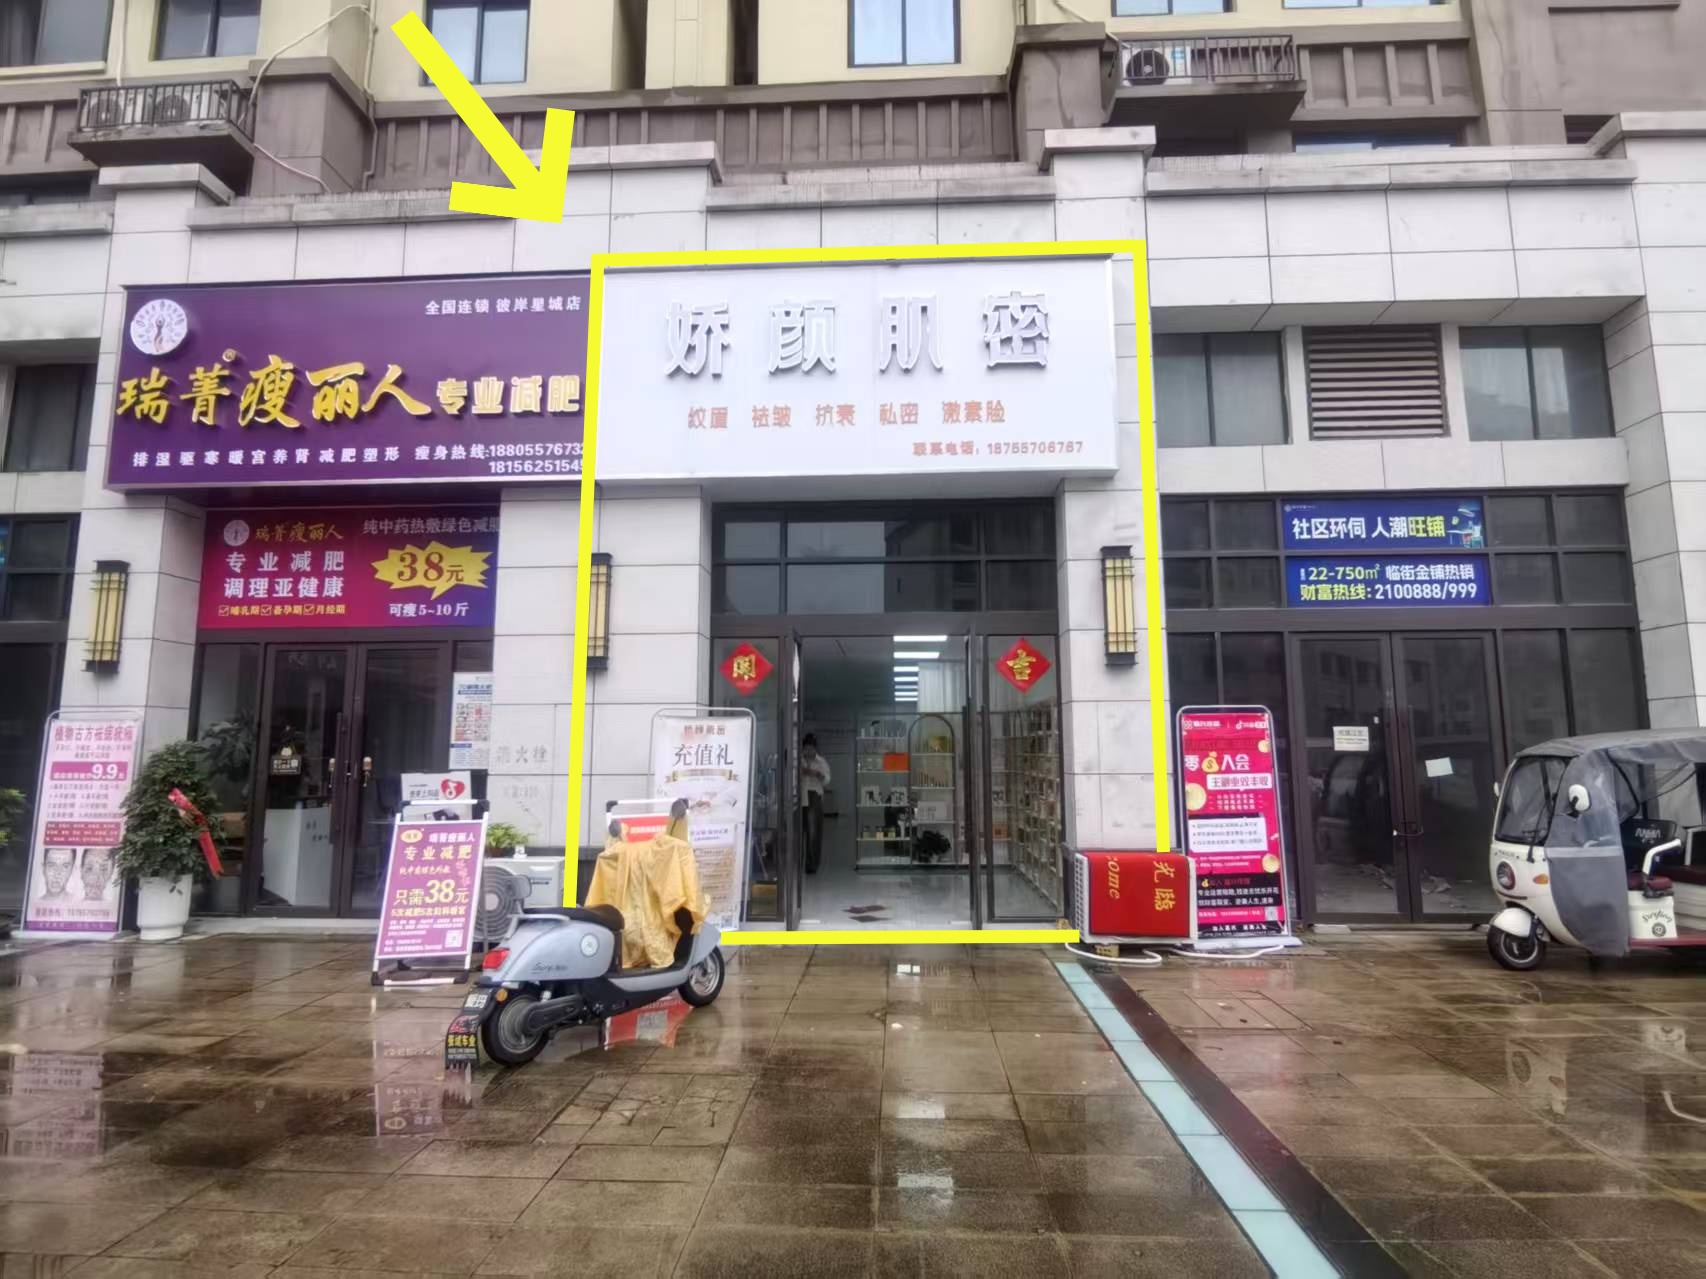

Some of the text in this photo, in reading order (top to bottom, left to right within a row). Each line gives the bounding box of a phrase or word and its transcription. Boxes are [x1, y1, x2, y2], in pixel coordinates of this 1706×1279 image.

[425, 296, 581, 316] 全国连锁 彼岸星城店
[665, 291, 1050, 379] 娇颜肌密
[116, 354, 580, 428] 瑞菁瘦丽人 专业减肥
[880, 401, 918, 426] 私密
[488, 459, 583, 474] 1815625154
[1292, 515, 1446, 540] 社区环伺 人潮旺铺
[225, 550, 344, 574] 专业减肥
[397, 551, 465, 583] 38元
[1385, 563, 1475, 581] 临街金铺热销
[224, 577, 344, 599] 调理亚健康
[672, 743, 734, 767] 充值礼
[393, 879, 470, 906] 只需38元
